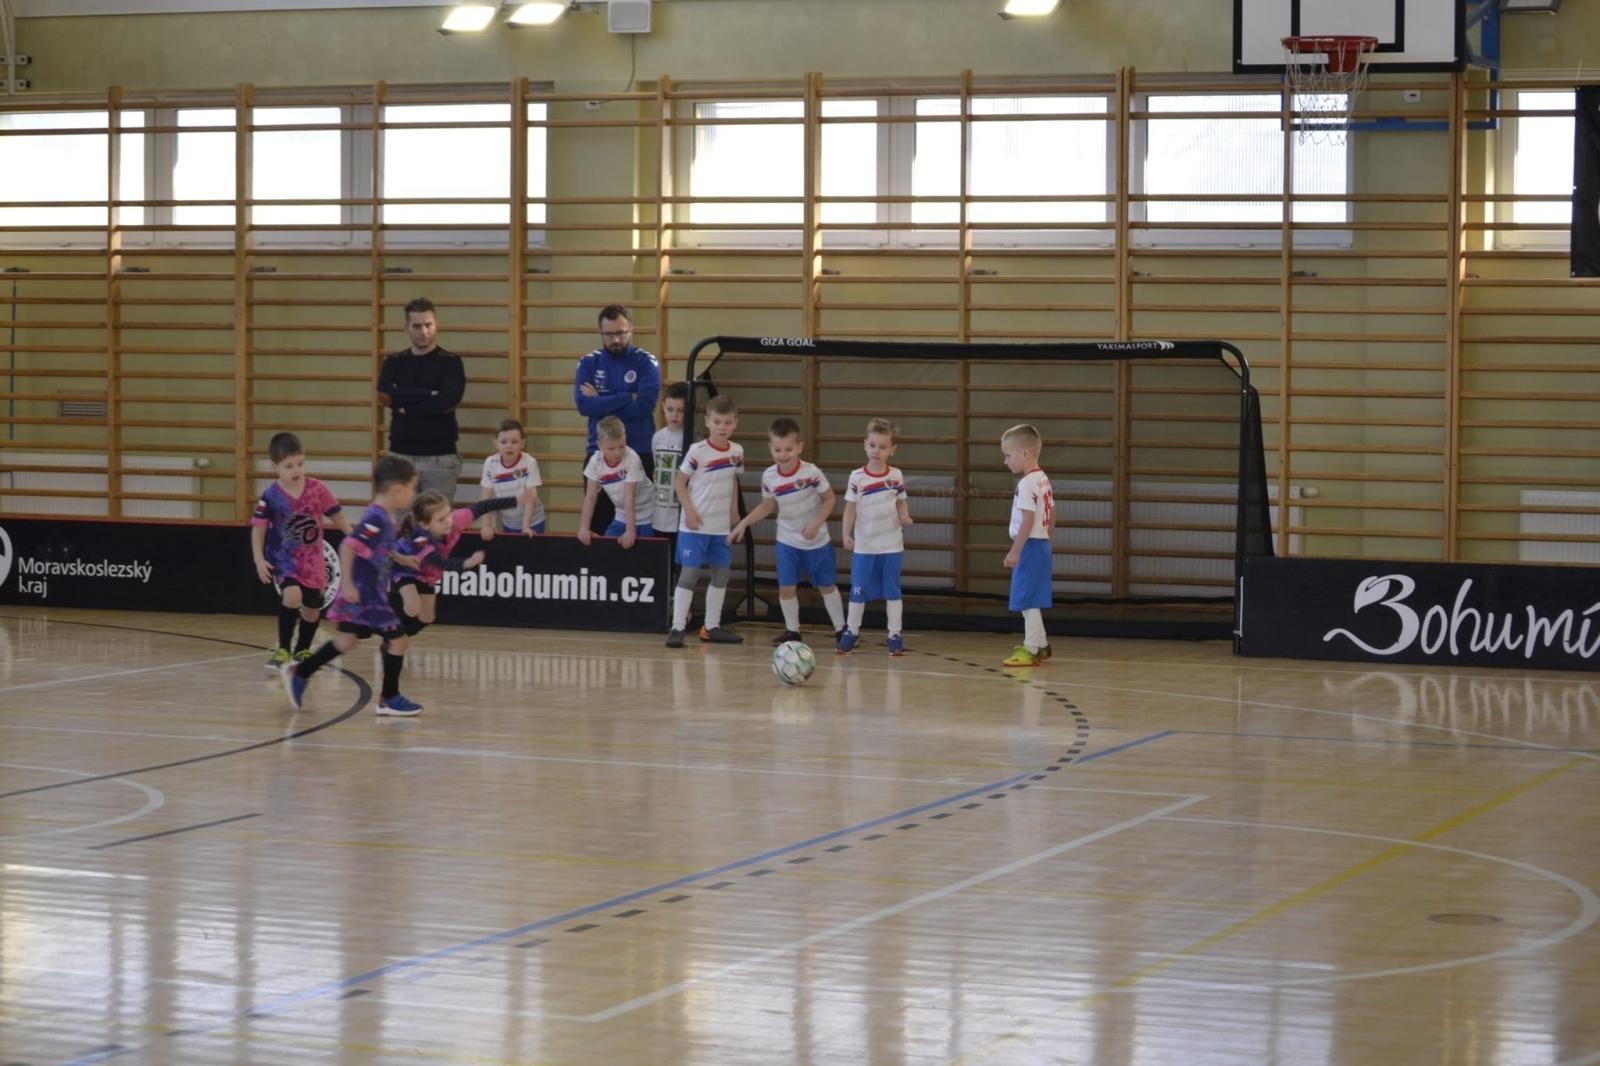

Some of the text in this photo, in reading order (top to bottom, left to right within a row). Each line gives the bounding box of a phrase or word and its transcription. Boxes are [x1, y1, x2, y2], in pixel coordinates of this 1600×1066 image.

[760, 337, 816, 347] GIZA GOAL
[1097, 342, 1158, 350] YAKIMASPORT
[18, 556, 152, 582] Moravskoslezský
[18, 575, 48, 598] kraj
